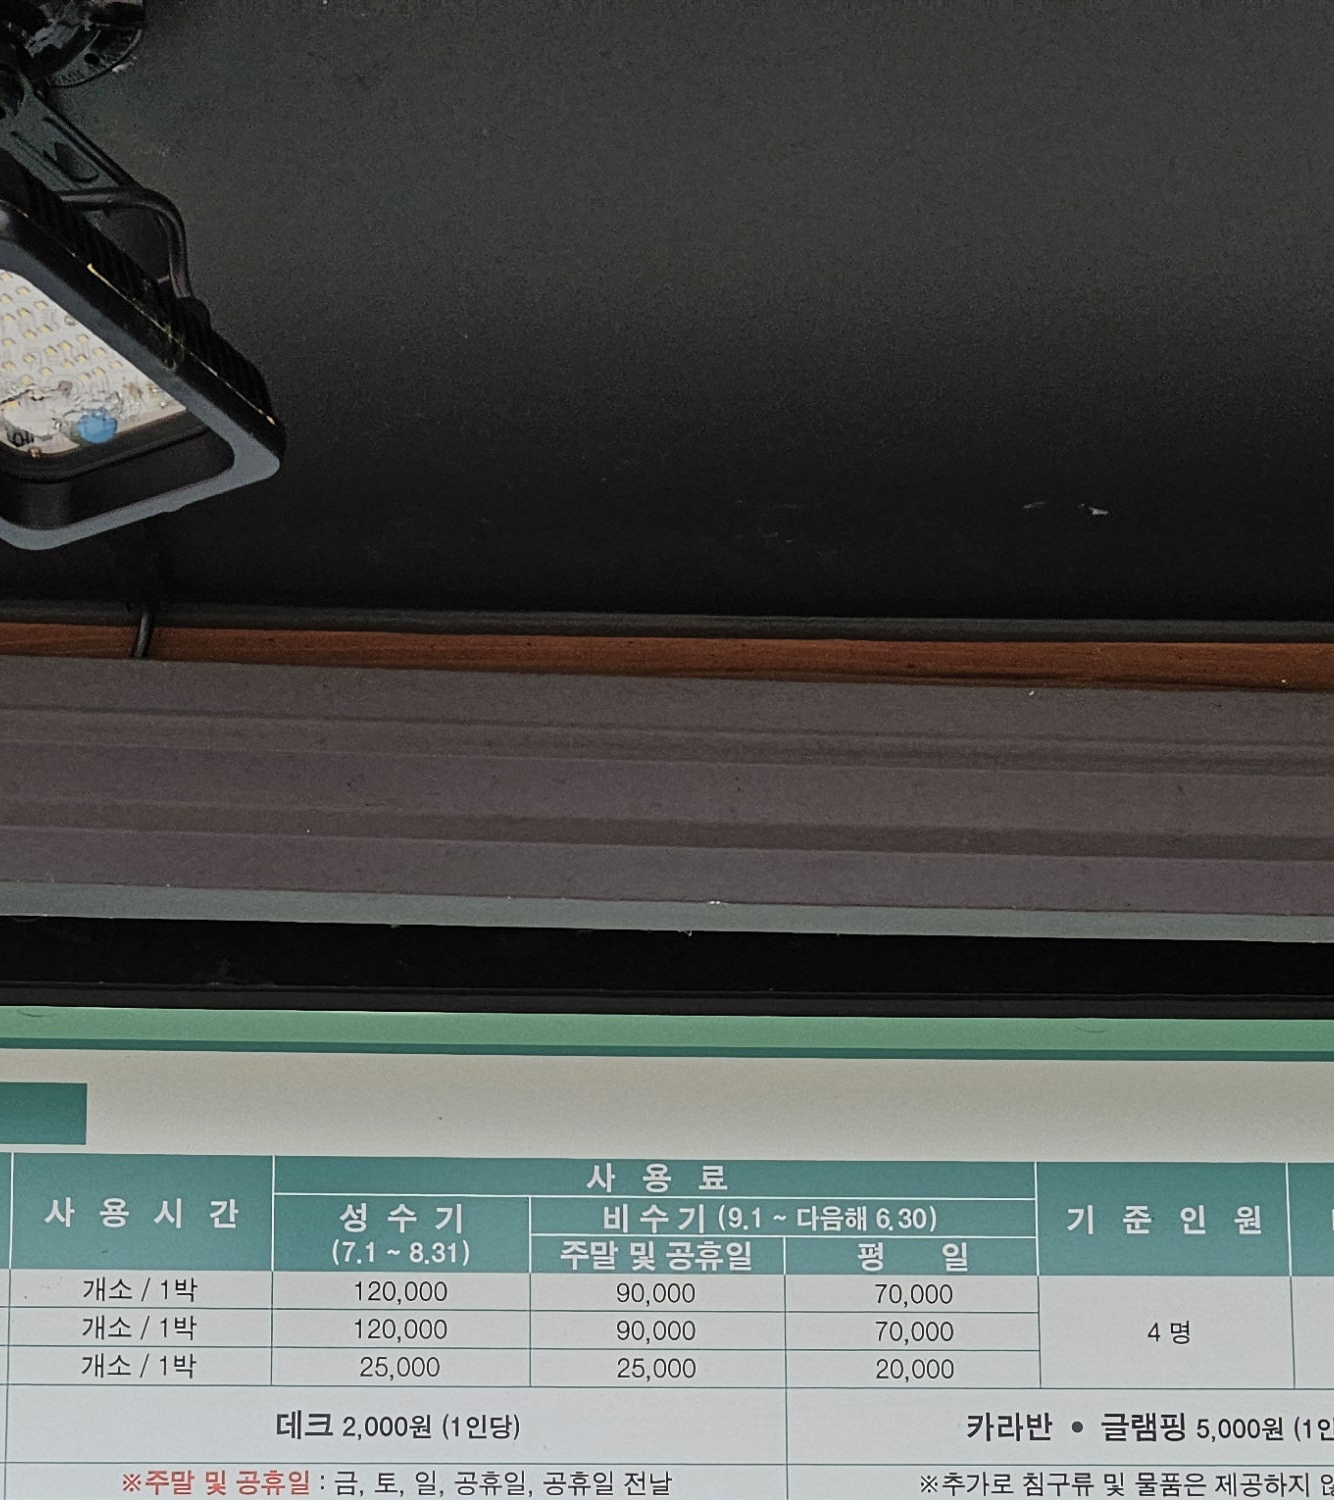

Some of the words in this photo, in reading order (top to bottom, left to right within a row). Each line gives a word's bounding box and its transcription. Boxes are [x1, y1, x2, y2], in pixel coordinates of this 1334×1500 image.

[561, 1241, 618, 1270] 주말
[666, 1241, 751, 1271] 공휴일
[355, 1281, 447, 1305] 120,000
[617, 1283, 695, 1306] 90,000
[875, 1284, 952, 1307] 70,000
[360, 1357, 440, 1380] 25,000
[618, 1358, 696, 1382] 25,000
[876, 1359, 954, 1382] 20,000
[277, 1410, 333, 1439] 데크
[343, 1415, 431, 1440] 2,000원
[968, 1412, 1052, 1441] 카라반
[1101, 1413, 1185, 1441] 글램핑
[1197, 1417, 1283, 1442] 5,000원
[1215, 1473, 1309, 1497] 제공하지
